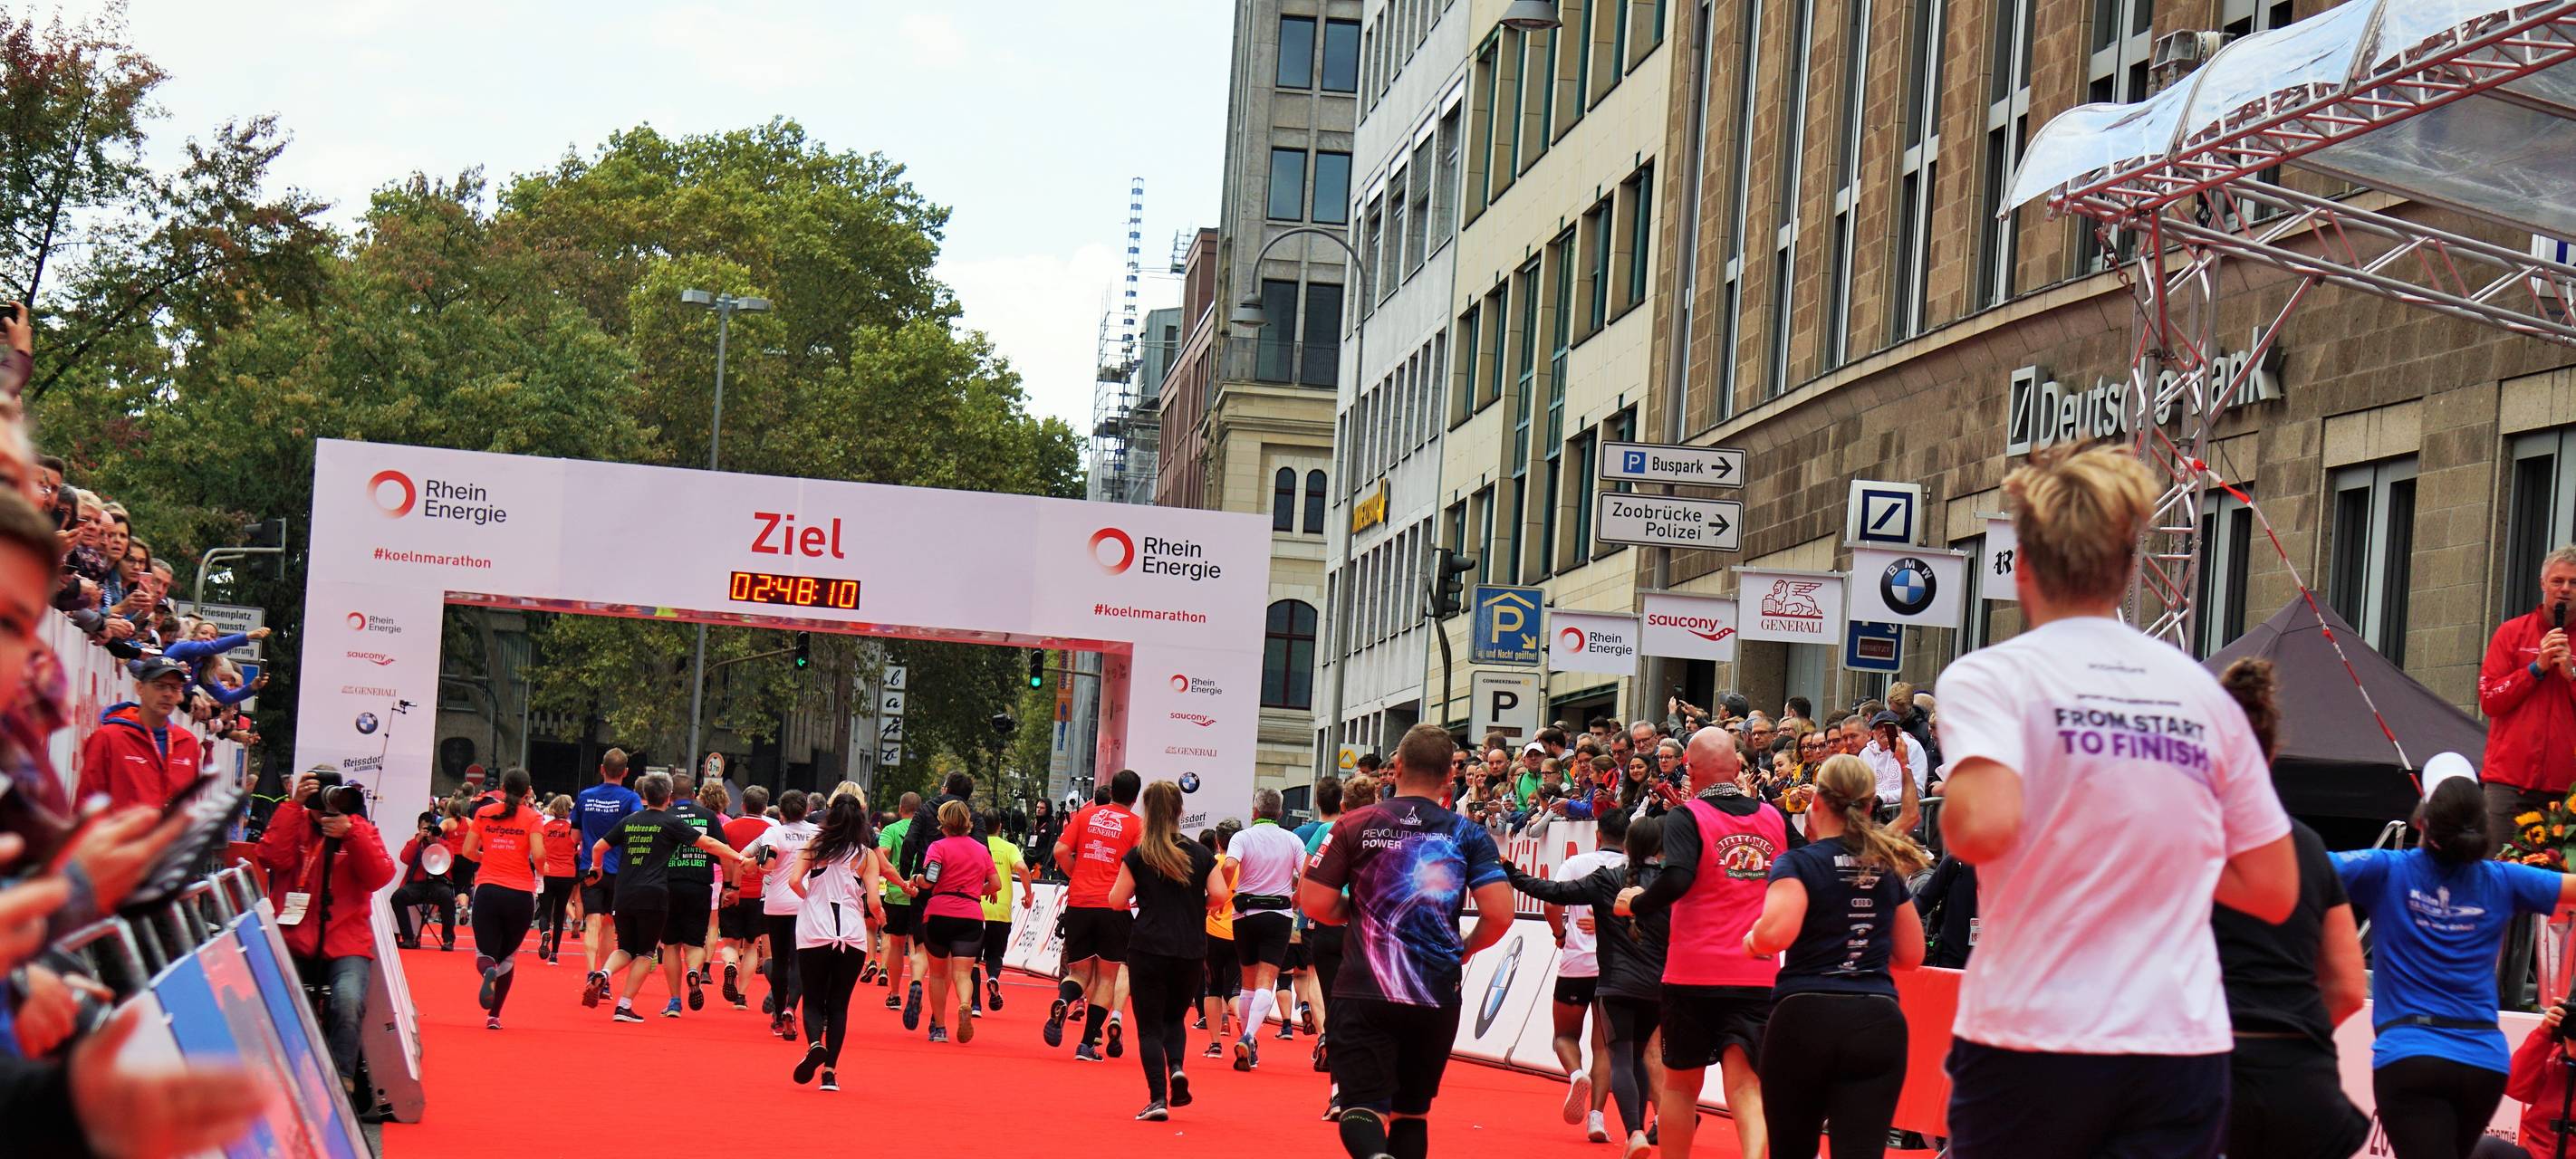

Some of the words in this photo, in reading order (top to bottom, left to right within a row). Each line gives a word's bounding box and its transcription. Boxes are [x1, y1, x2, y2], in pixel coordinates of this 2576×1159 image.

[2038, 357, 2172, 451] Deutsce
[2191, 326, 2267, 416] ank
[1652, 456, 1704, 475] Buspark
[426, 480, 486, 502] Rhein
[425, 500, 507, 525] Energie
[1612, 502, 1702, 522] Zoobrücke
[752, 512, 844, 559] Ziel
[1645, 522, 1701, 540] Polizei
[1144, 536, 1202, 558] Rhein
[373, 547, 491, 569] #koelnmarathon
[1142, 556, 1221, 581] Energie
[1887, 559, 1933, 580] BMW
[732, 573, 857, 608] 02:48:10
[200, 607, 252, 621] Friesenplatz
[370, 615, 394, 625] Rhein
[1094, 603, 1206, 624] #koelnmarathon
[217, 622, 247, 632] nusstr.
[369, 623, 402, 634] Energie
[1648, 613, 1718, 632] saucony
[1761, 619, 1822, 634] GENERALI
[1590, 632, 1622, 644] Rhein
[347, 651, 386, 661] saucony
[1498, 649, 1514, 660] Nacht
[1514, 650, 1537, 662] geöffnet
[1589, 643, 1633, 656] Energie
[1191, 677, 1216, 686] Rhein
[354, 686, 398, 697] GENERALI
[1191, 685, 1223, 695] Energie
[1492, 691, 1519, 722] P
[1170, 712, 1207, 722] saucony
[2053, 708, 2125, 730] FROM
[2132, 715, 2206, 742] START
[1177, 747, 1218, 757] GENERALI
[2057, 730, 2104, 755] TO
[2112, 733, 2210, 771] FINISH
[1180, 812, 1206, 824] ssdorf
[1087, 826, 1120, 839] GENERALI
[1362, 839, 1402, 849] POWER
